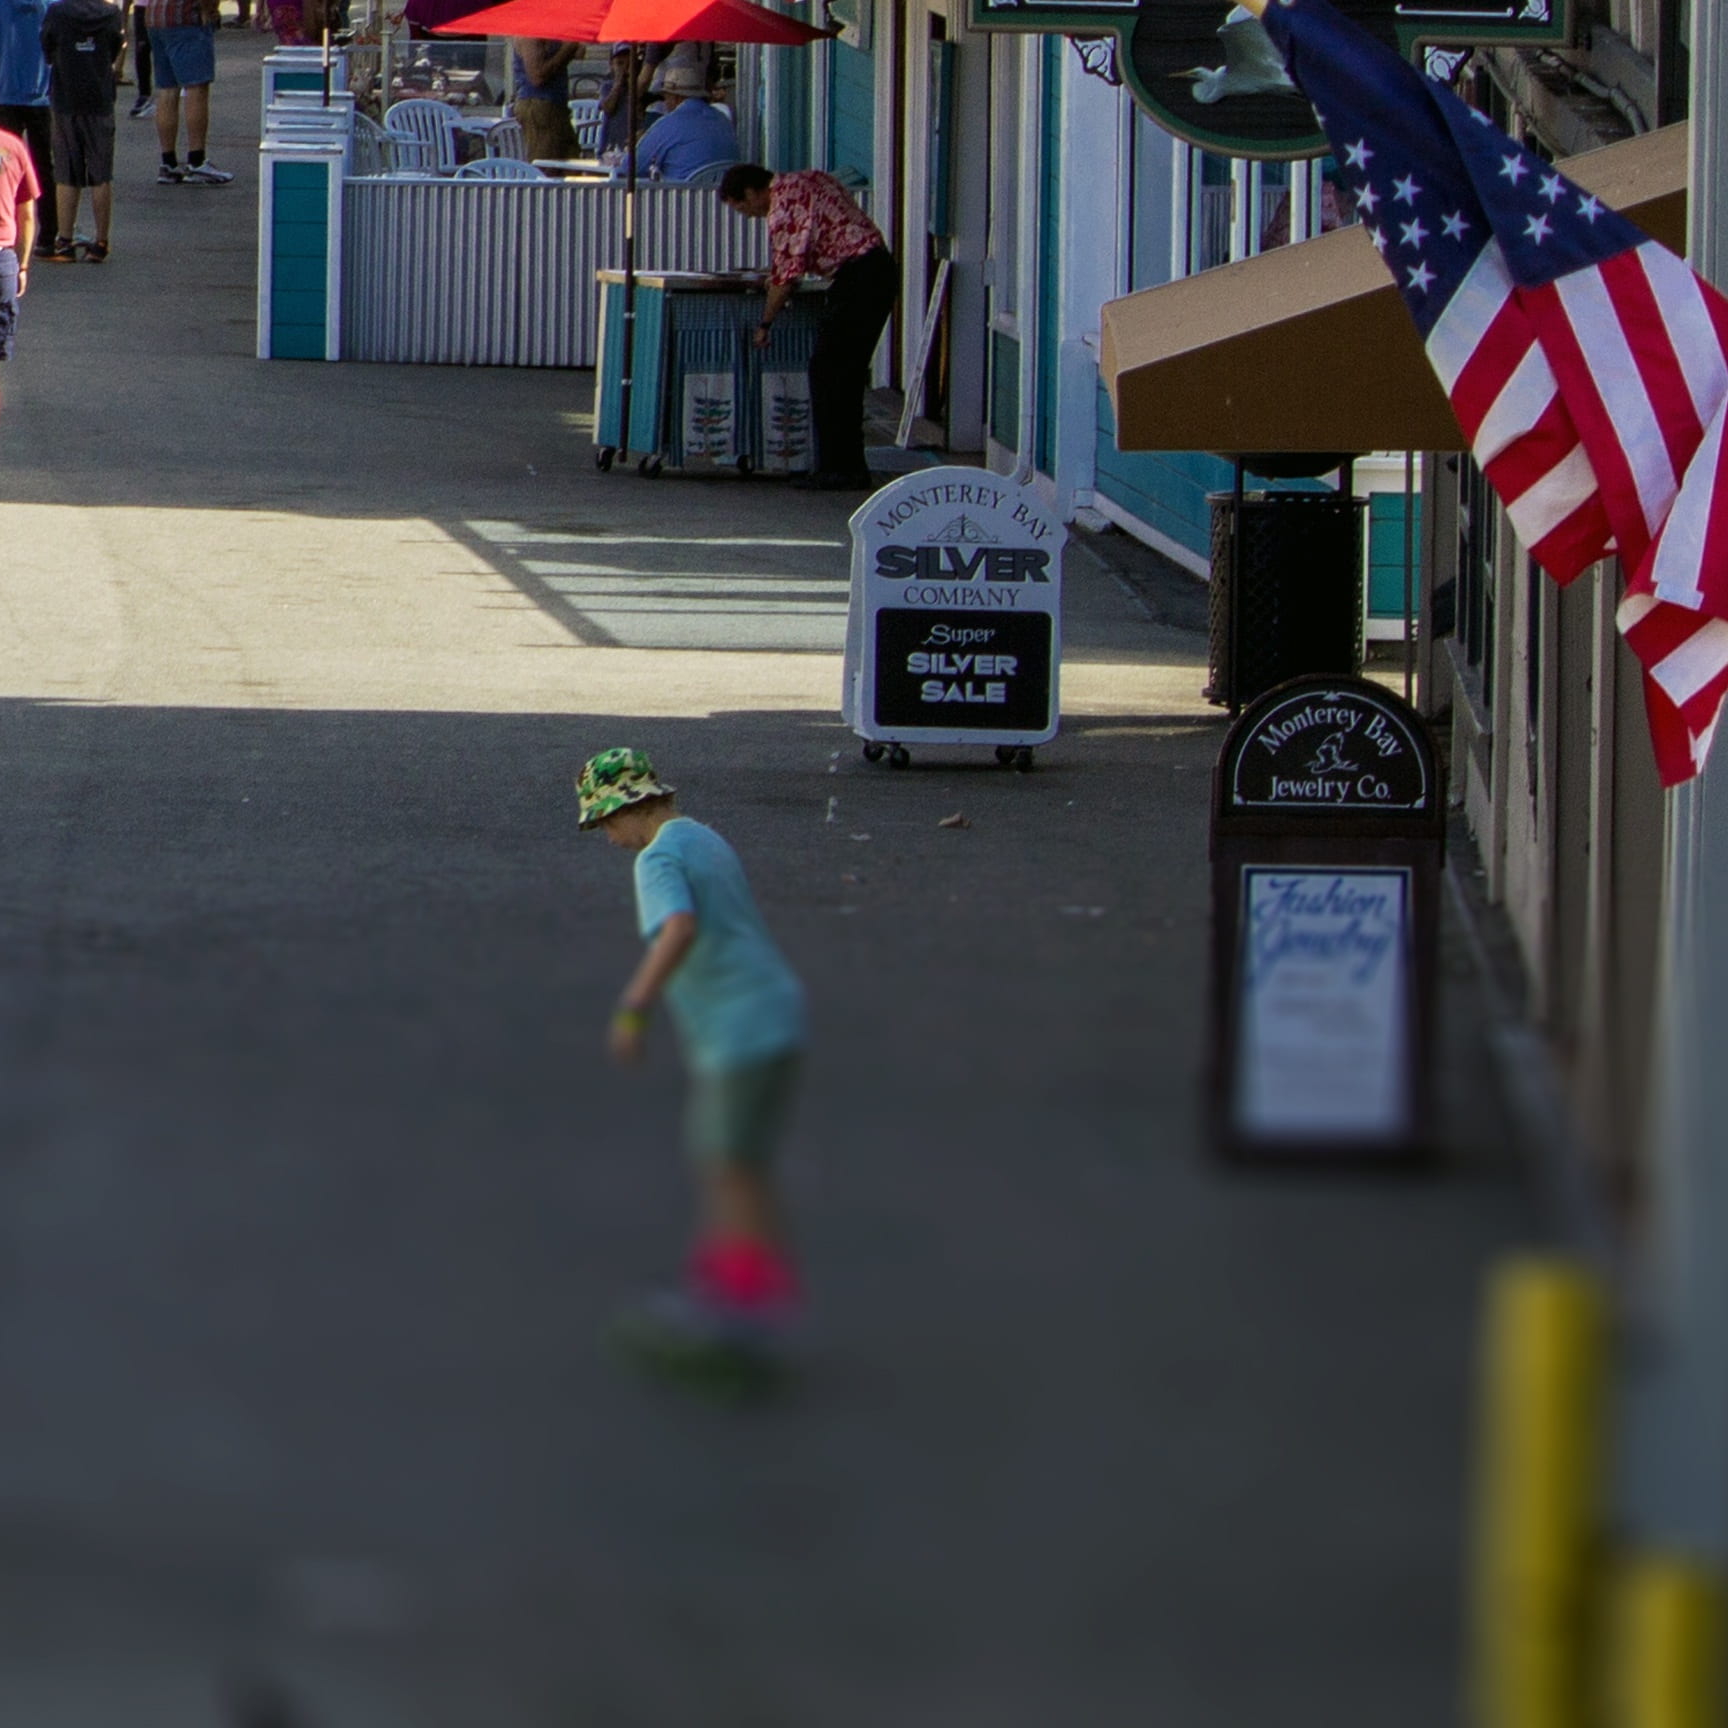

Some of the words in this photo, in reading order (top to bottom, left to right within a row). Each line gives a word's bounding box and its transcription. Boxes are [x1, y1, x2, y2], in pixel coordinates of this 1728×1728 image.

[877, 484, 1006, 536] MONTEREY
[1011, 503, 1053, 541] BAY
[875, 545, 1051, 582] SILVER
[903, 586, 1022, 607] COMPANY
[921, 624, 996, 647] Super
[907, 652, 1018, 675] SILVER
[921, 680, 1006, 704] SALE
[1258, 706, 1363, 755] Monterey
[1364, 714, 1402, 758] Bay
[1268, 776, 1350, 803] Jewelry
[1357, 774, 1392, 799] Co.
[1253, 877, 1387, 921] Fashion
